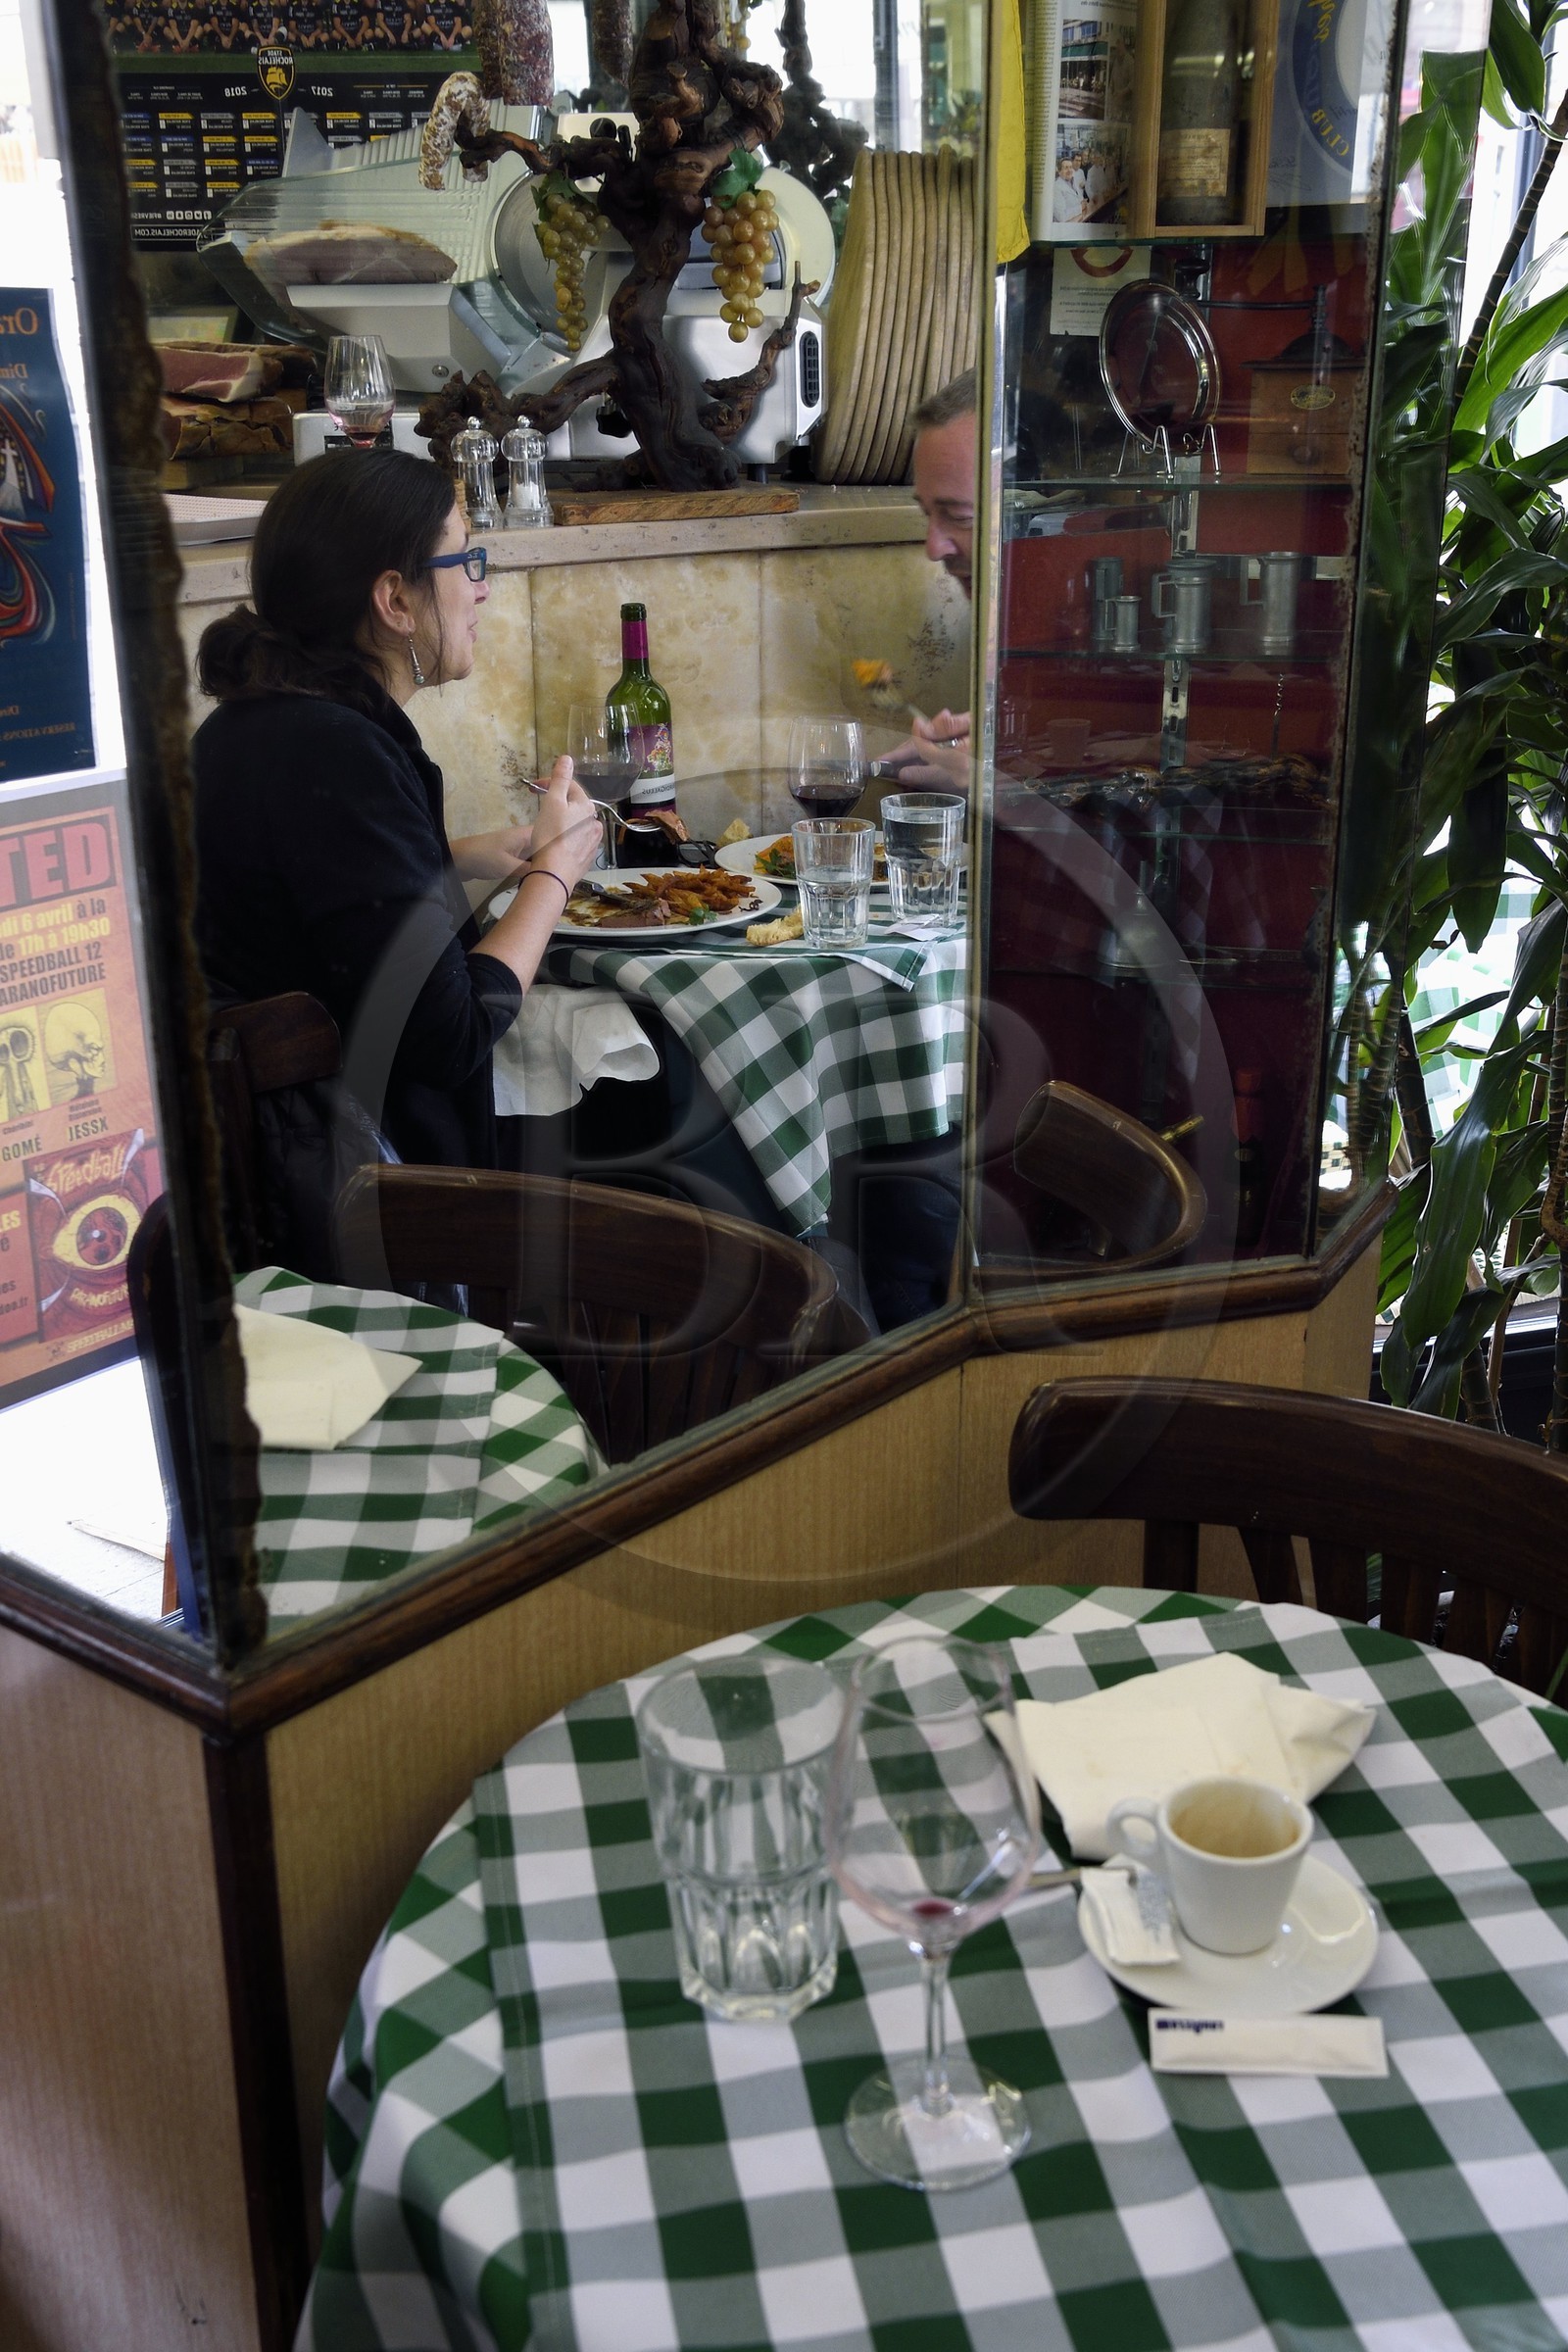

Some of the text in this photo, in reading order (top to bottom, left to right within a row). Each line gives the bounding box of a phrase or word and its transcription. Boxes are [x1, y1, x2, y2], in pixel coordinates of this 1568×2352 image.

[0, 898, 107, 938] di 6 avril à la
[18, 934, 45, 956] 17h
[47, 929, 59, 949] à
[61, 916, 111, 945] 19h30
[0, 941, 103, 984] SPEEDBALL 12
[0, 962, 106, 1007] ARANOFUTURE
[2, 1133, 43, 1161] GOMÉ
[69, 1115, 110, 1142] JESSX
[0, 1209, 22, 1233] ES
